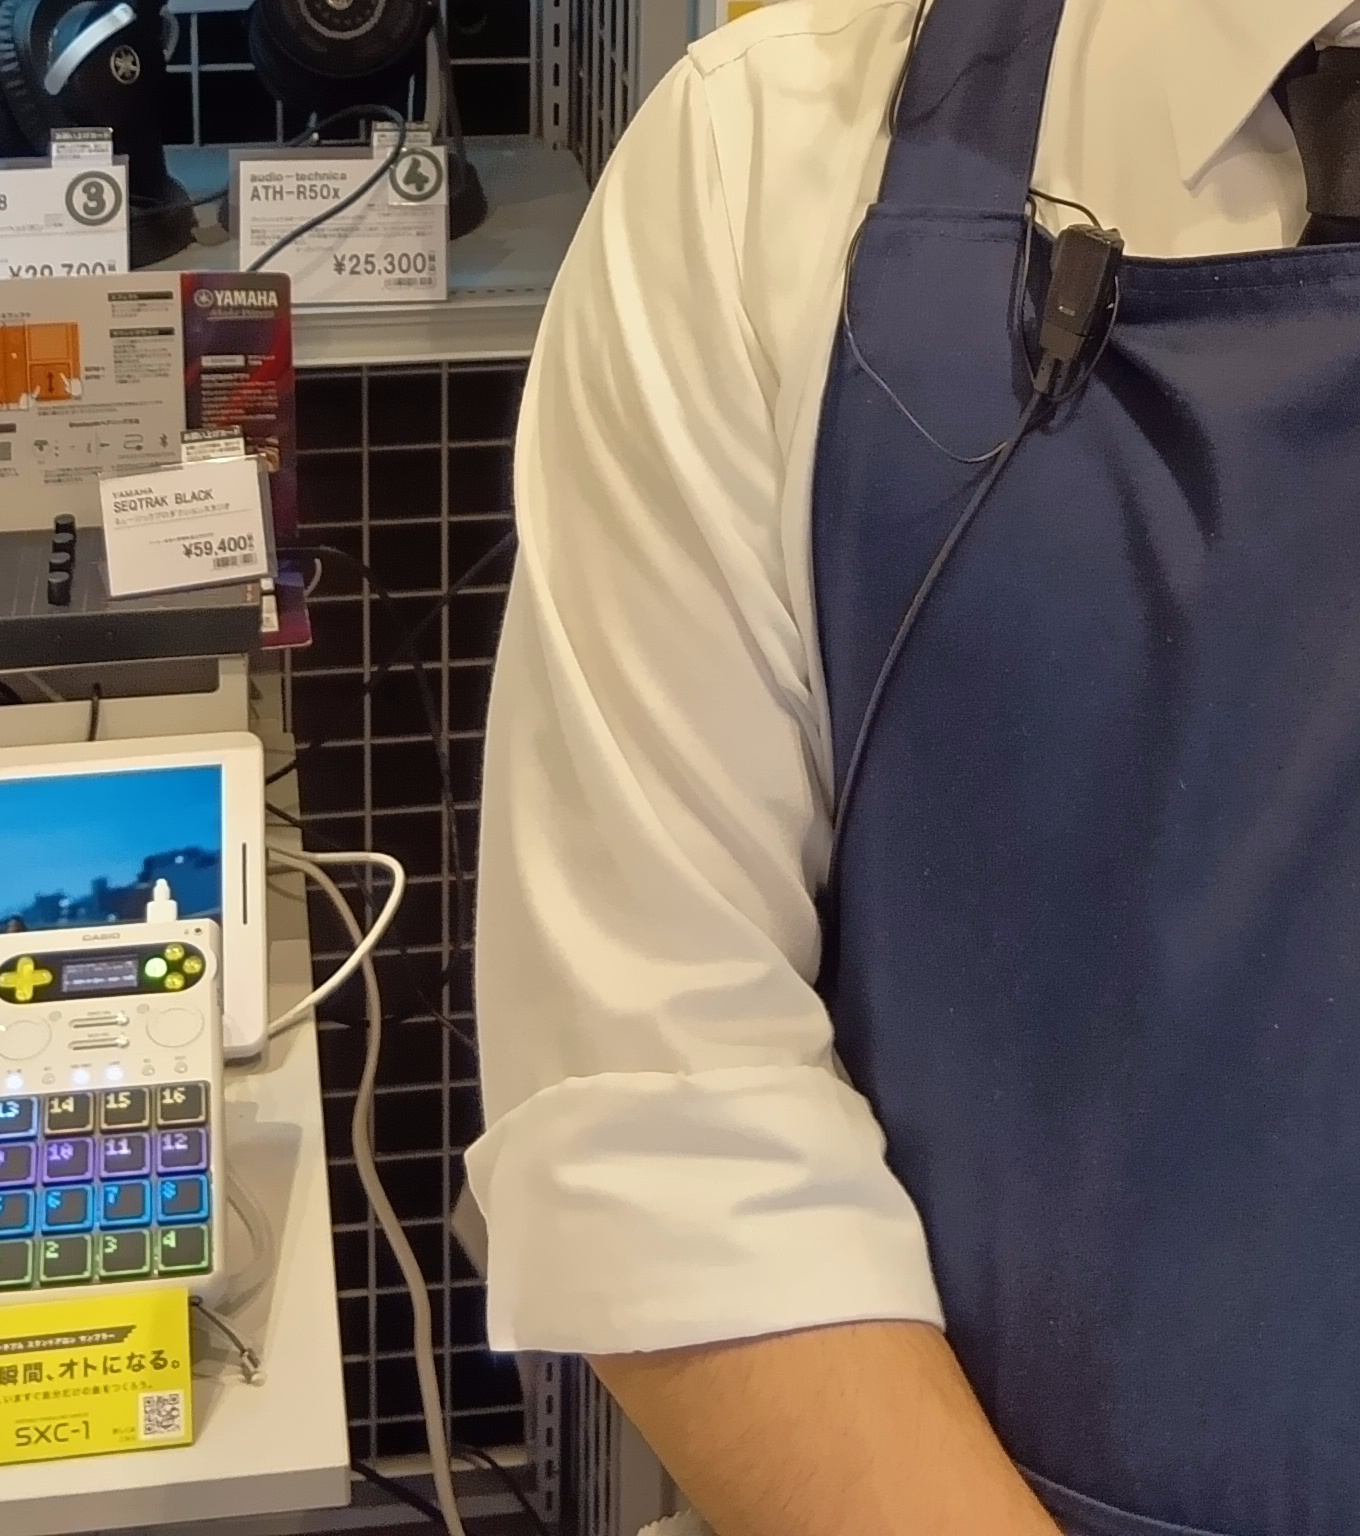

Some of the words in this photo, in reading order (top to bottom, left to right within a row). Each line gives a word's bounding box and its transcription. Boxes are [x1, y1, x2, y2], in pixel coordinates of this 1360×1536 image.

[249, 183, 341, 202] ATH-R50x
[332, 252, 427, 277] ¥25,300
[214, 289, 279, 308] YAMAHA
[113, 495, 169, 514] SEQTRAK
[174, 488, 215, 505] BLACK
[105, 1092, 132, 1109] 15
[160, 1087, 186, 1105] 16
[49, 1097, 75, 1114] 14
[104, 1138, 132, 1155] 11
[161, 1133, 189, 1151] 12
[103, 1235, 118, 1253] 3
[162, 1230, 177, 1249] 4
[45, 1241, 60, 1259] 2
[14, 1419, 91, 1447] SXC-1
